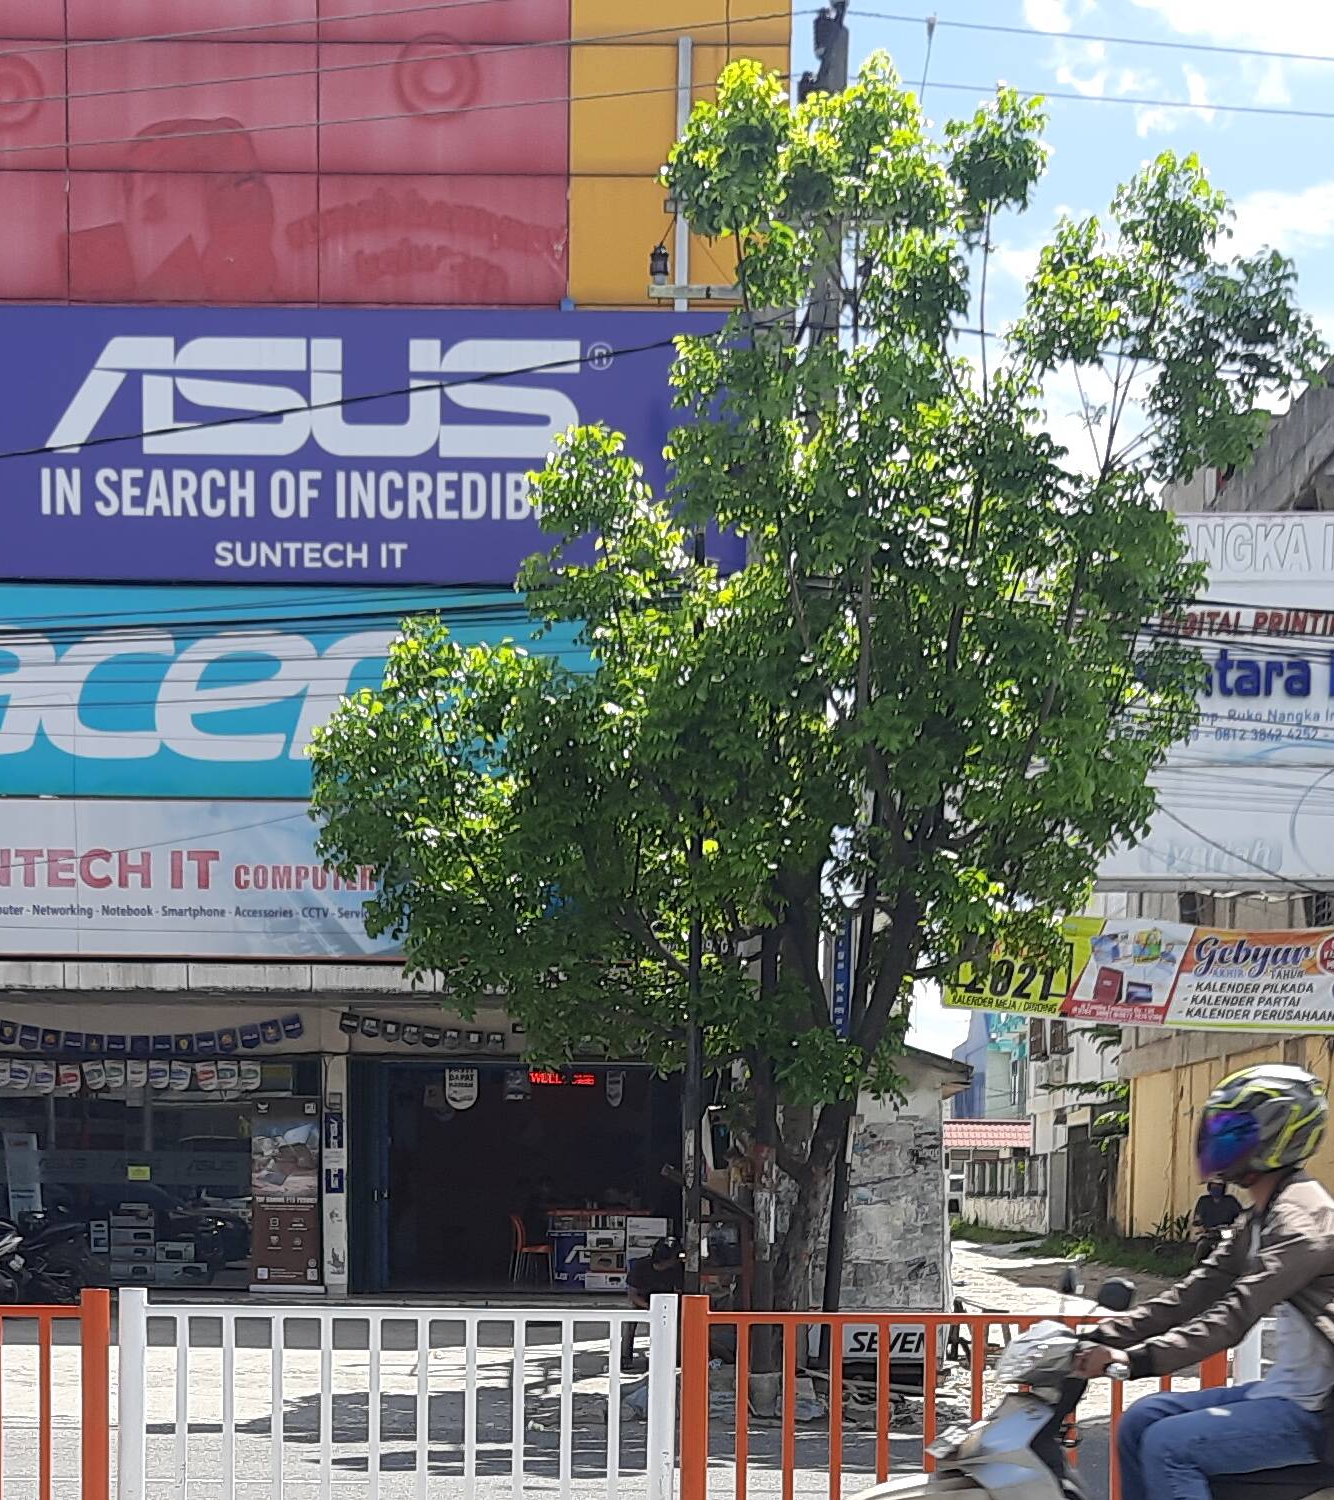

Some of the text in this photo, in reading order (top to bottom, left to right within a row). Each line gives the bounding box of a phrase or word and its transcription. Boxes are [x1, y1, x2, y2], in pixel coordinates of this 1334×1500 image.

[45, 336, 582, 458] ASUS
[40, 468, 82, 516] IN
[94, 468, 255, 518] SEARCH
[270, 469, 318, 519] OF
[215, 542, 408, 568] SUNTECH IT
[1227, 709, 1263, 722] Ruko
[1268, 709, 1320, 724] Nangka
[170, 850, 220, 890] IT
[234, 864, 376, 891] COMPUTER
[32, 904, 93, 919] Networking
[101, 905, 153, 917] Notebook
[161, 905, 226, 919] Smartphone
[234, 907, 294, 919] Accessories
[301, 907, 329, 919] CCTV
[1194, 936, 1313, 978] Gebyar
[1195, 981, 1314, 994] KALENDER PILKADA
[1189, 994, 1302, 1007] KALENDER PARTAI
[1185, 1007, 1251, 1020] KALENDER
